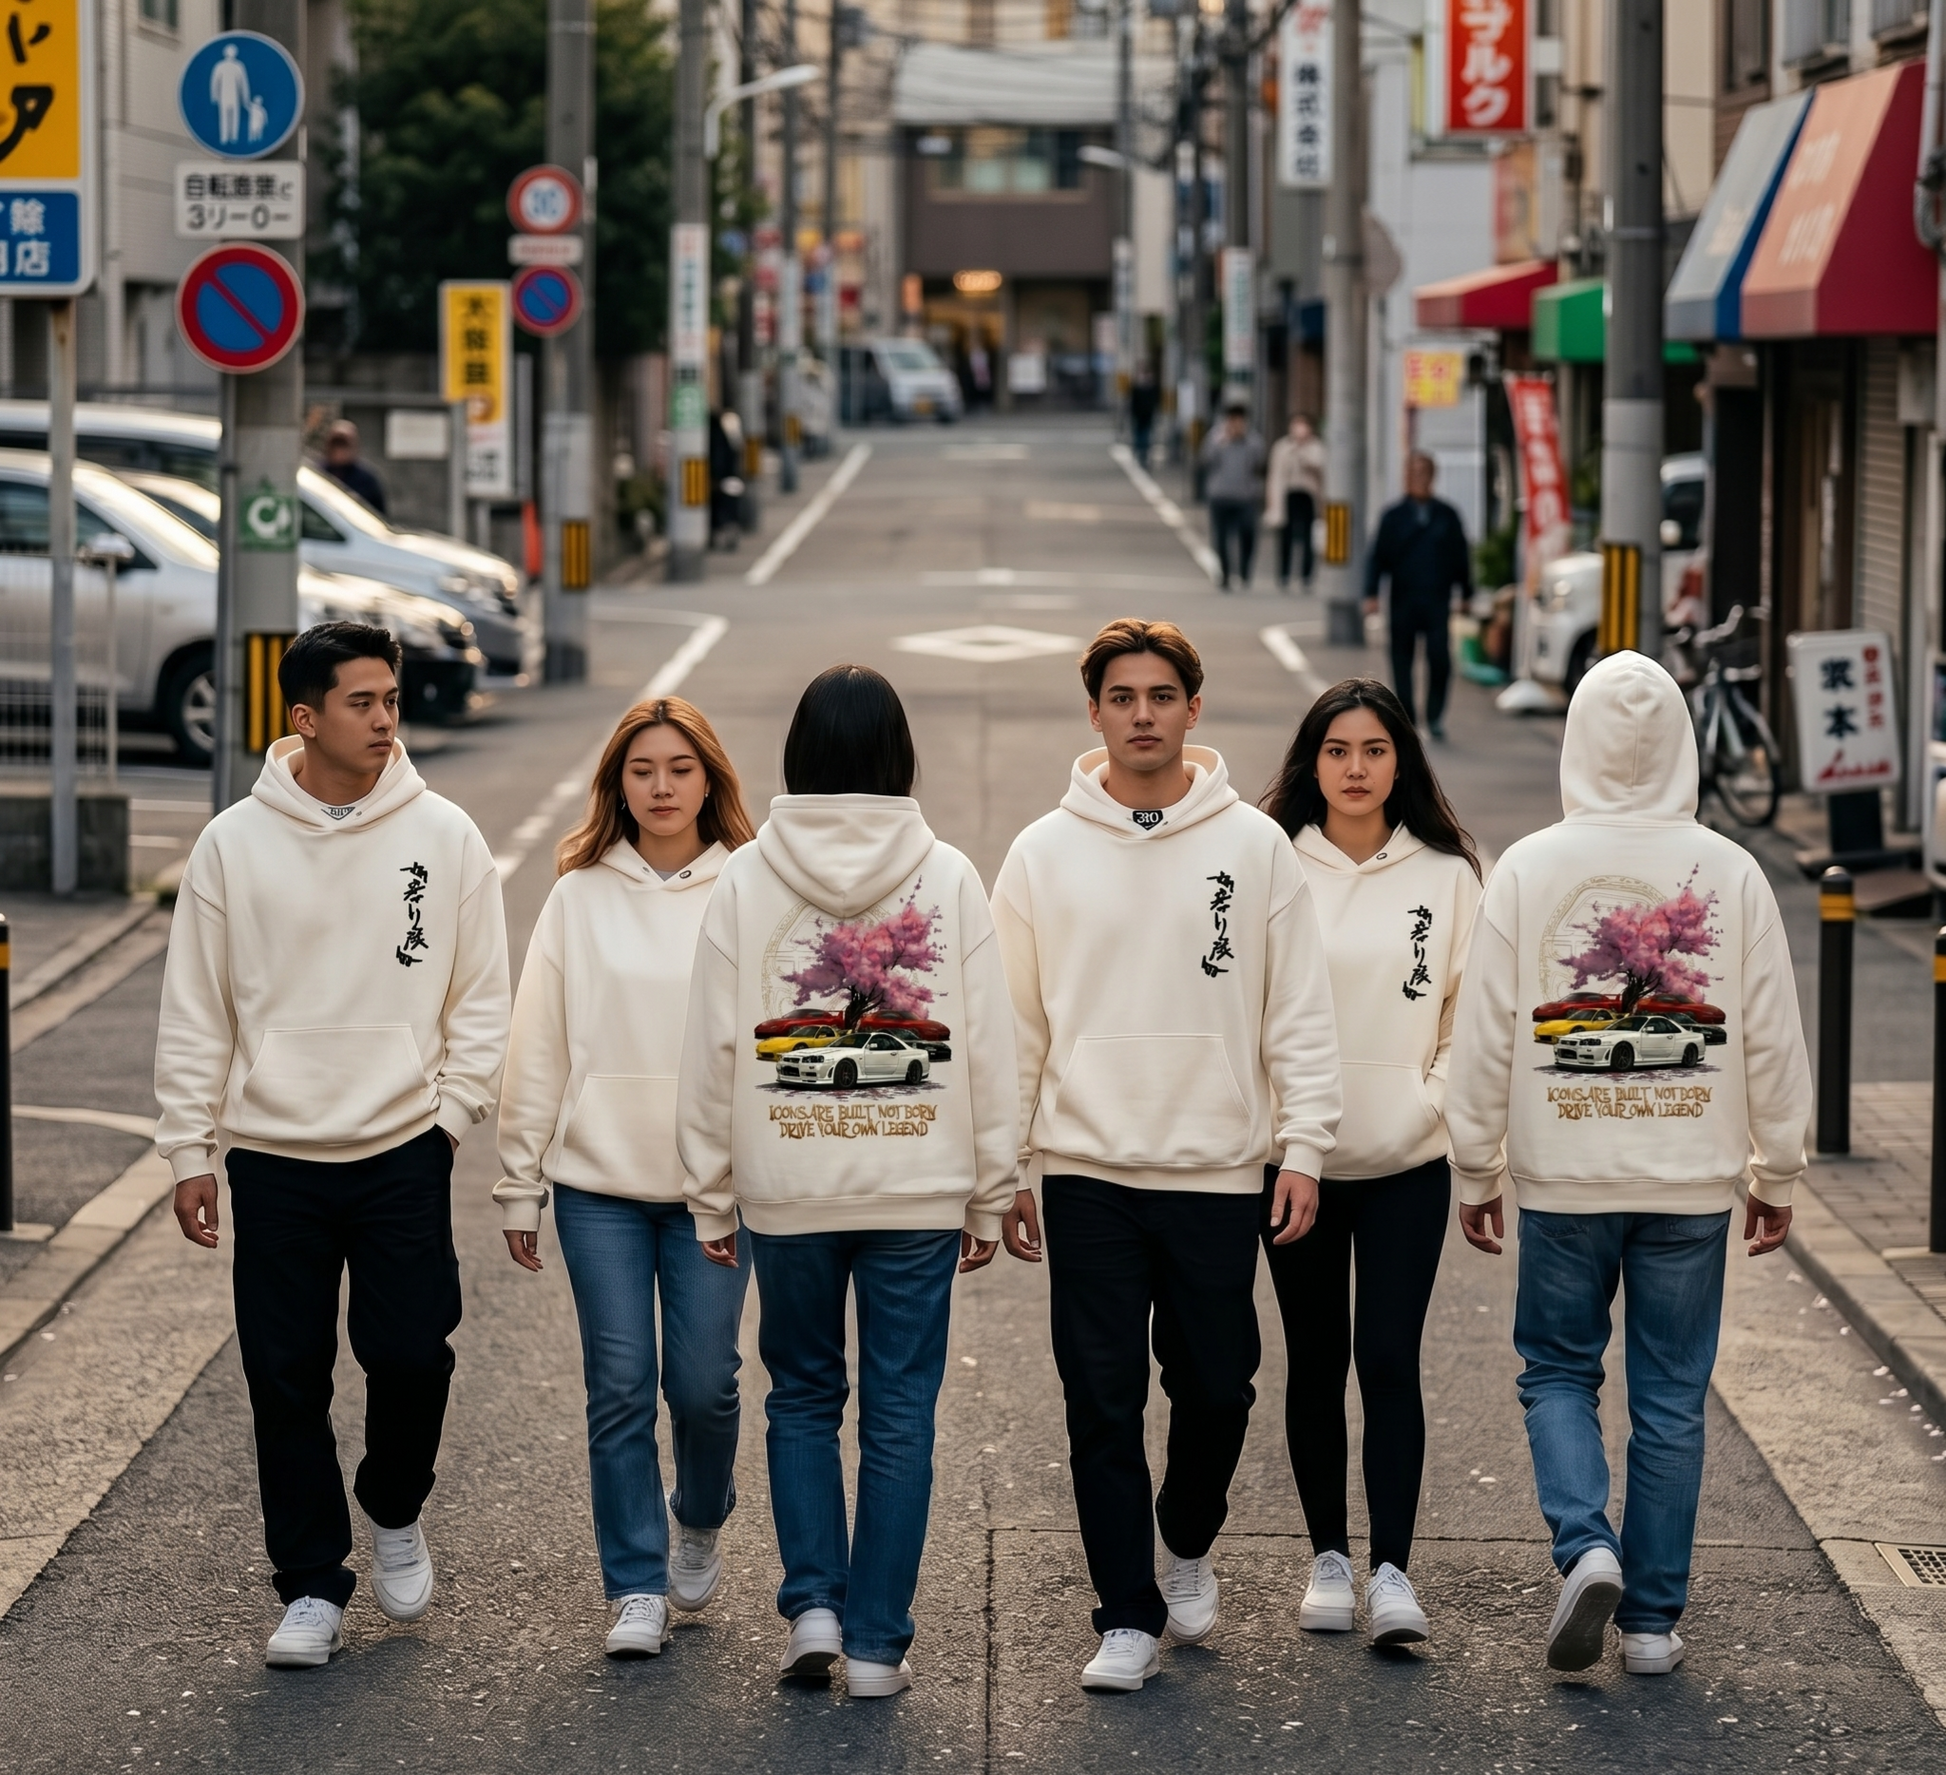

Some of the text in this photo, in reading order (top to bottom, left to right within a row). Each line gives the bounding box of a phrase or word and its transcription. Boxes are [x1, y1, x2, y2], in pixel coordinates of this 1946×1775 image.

[1654, 1087, 1680, 1101] NOT
[878, 1104, 903, 1119] NOT
[1557, 1103, 1592, 1120] DRIVE
[1594, 1102, 1633, 1119] YOUR
[1658, 1101, 1704, 1118] LEGEND
[779, 1121, 815, 1139] DRIVE
[817, 1121, 856, 1139] YOUR
[882, 1120, 928, 1137] LEGEND
